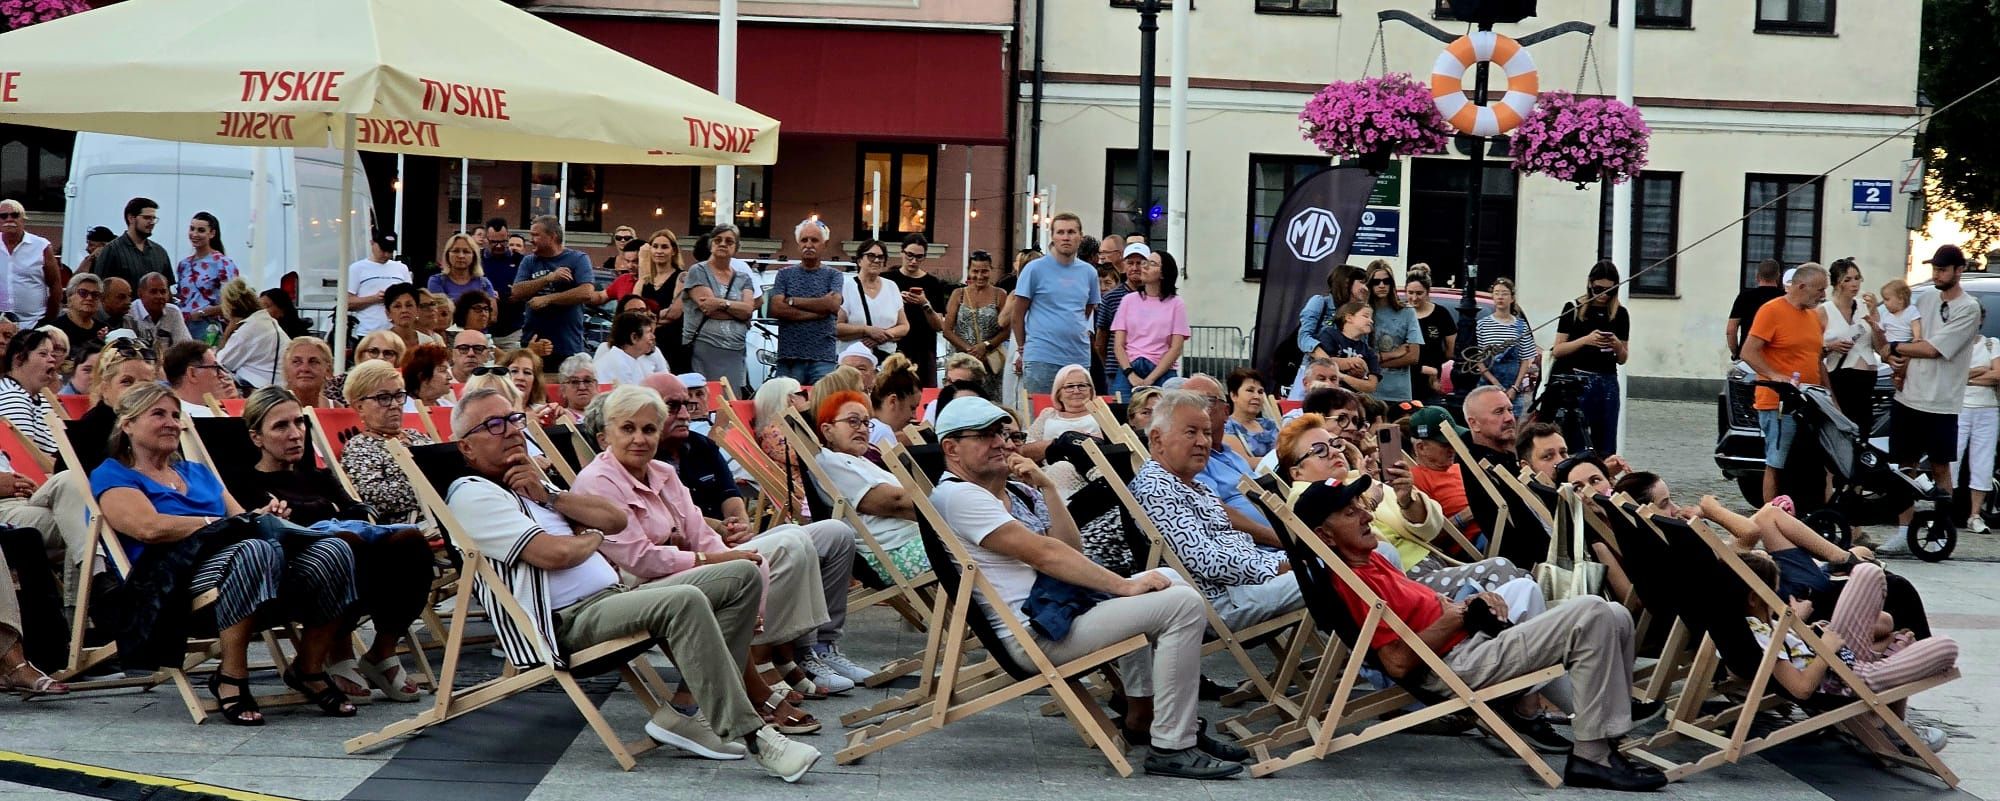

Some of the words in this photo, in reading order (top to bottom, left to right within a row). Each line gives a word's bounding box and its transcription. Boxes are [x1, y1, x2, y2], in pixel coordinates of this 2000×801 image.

[240, 71, 344, 101] TYSKIE
[419, 78, 510, 120] TYSKIE
[683, 116, 760, 154] TYSKIE
[1866, 187, 1880, 203] 2
[1291, 212, 1336, 257] MG
